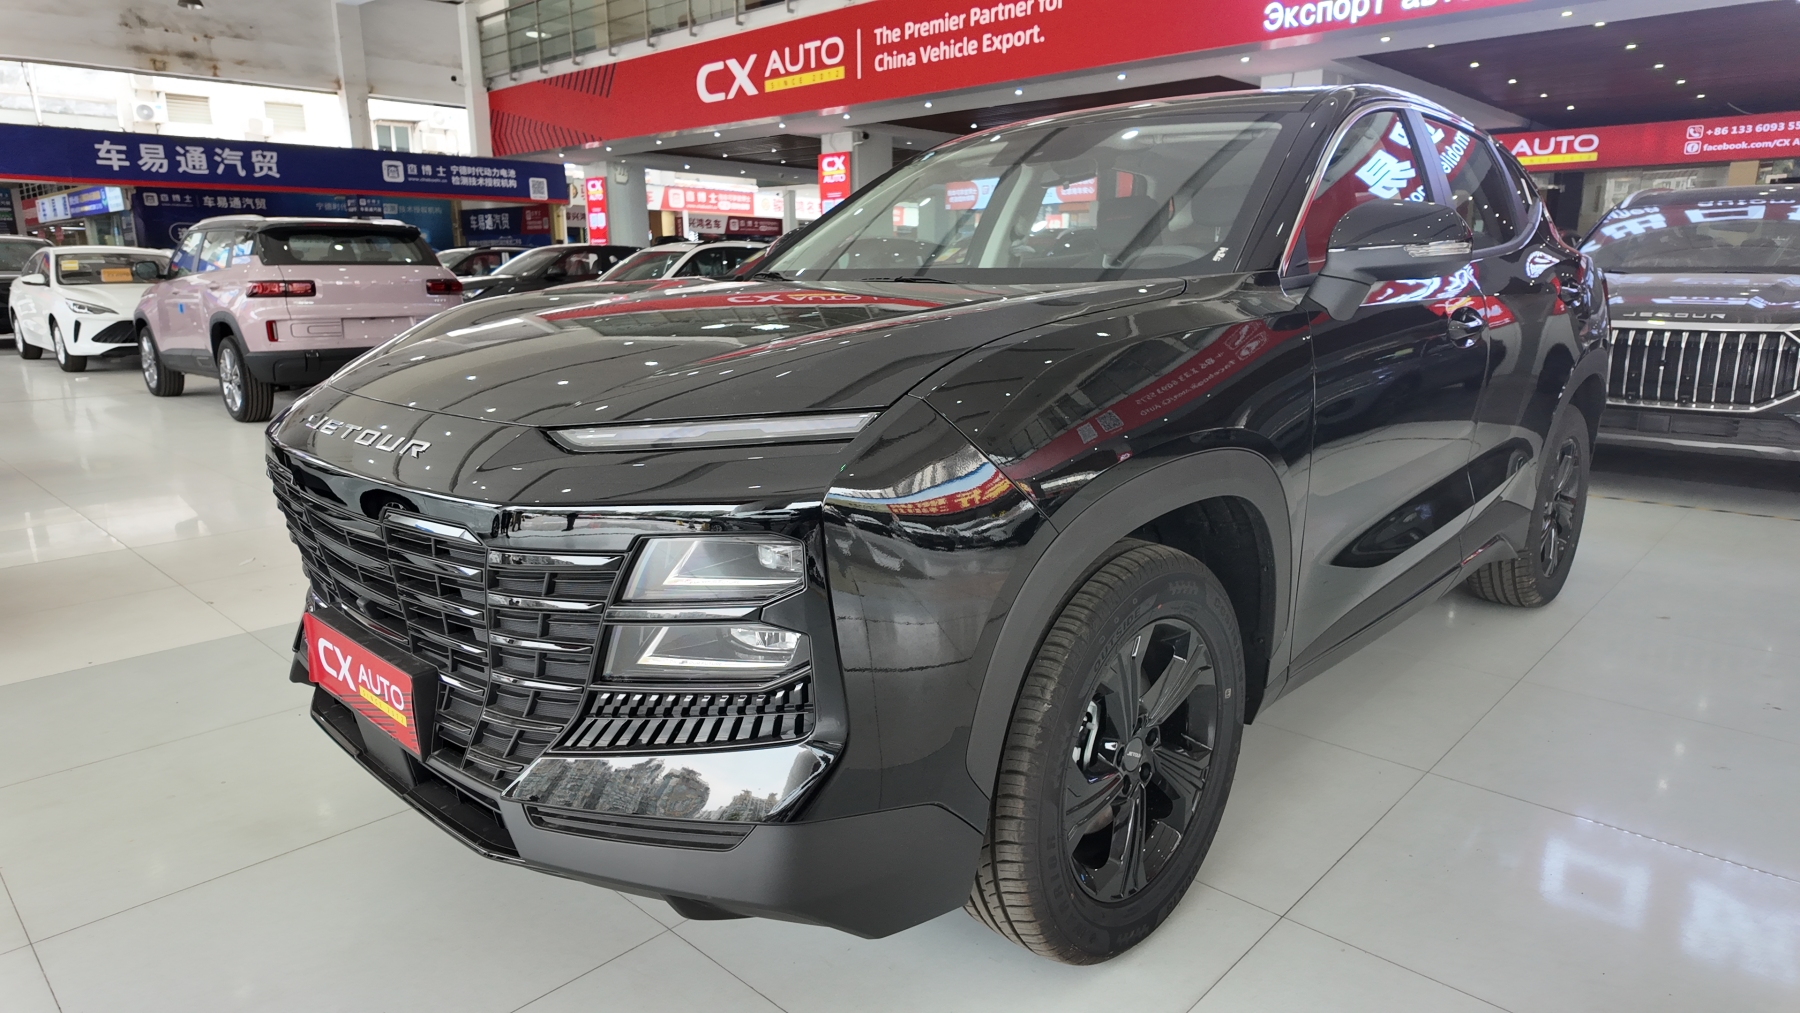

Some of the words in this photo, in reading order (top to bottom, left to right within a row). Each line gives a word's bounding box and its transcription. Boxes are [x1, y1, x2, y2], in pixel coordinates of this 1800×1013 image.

[874, 25, 901, 46] The
[904, 12, 966, 40] Premier
[970, 0, 1034, 27] Partner
[874, 50, 917, 72] China
[919, 36, 978, 64] Vehicle
[982, 24, 1045, 54] Export.
[696, 53, 759, 104] CX
[764, 36, 844, 78] AUTO
[1510, 134, 1600, 156] AUTO
[1706, 126, 1729, 136] +86
[1730, 125, 1753, 135] 133
[1755, 122, 1785, 133] 6093
[94, 139, 281, 179] 车易通汽贸
[821, 155, 846, 172] CX
[202, 195, 268, 211] 车易通汽贸
[305, 415, 433, 459] JETOUR
[317, 637, 357, 693] CX
[358, 663, 406, 712] AUTO
